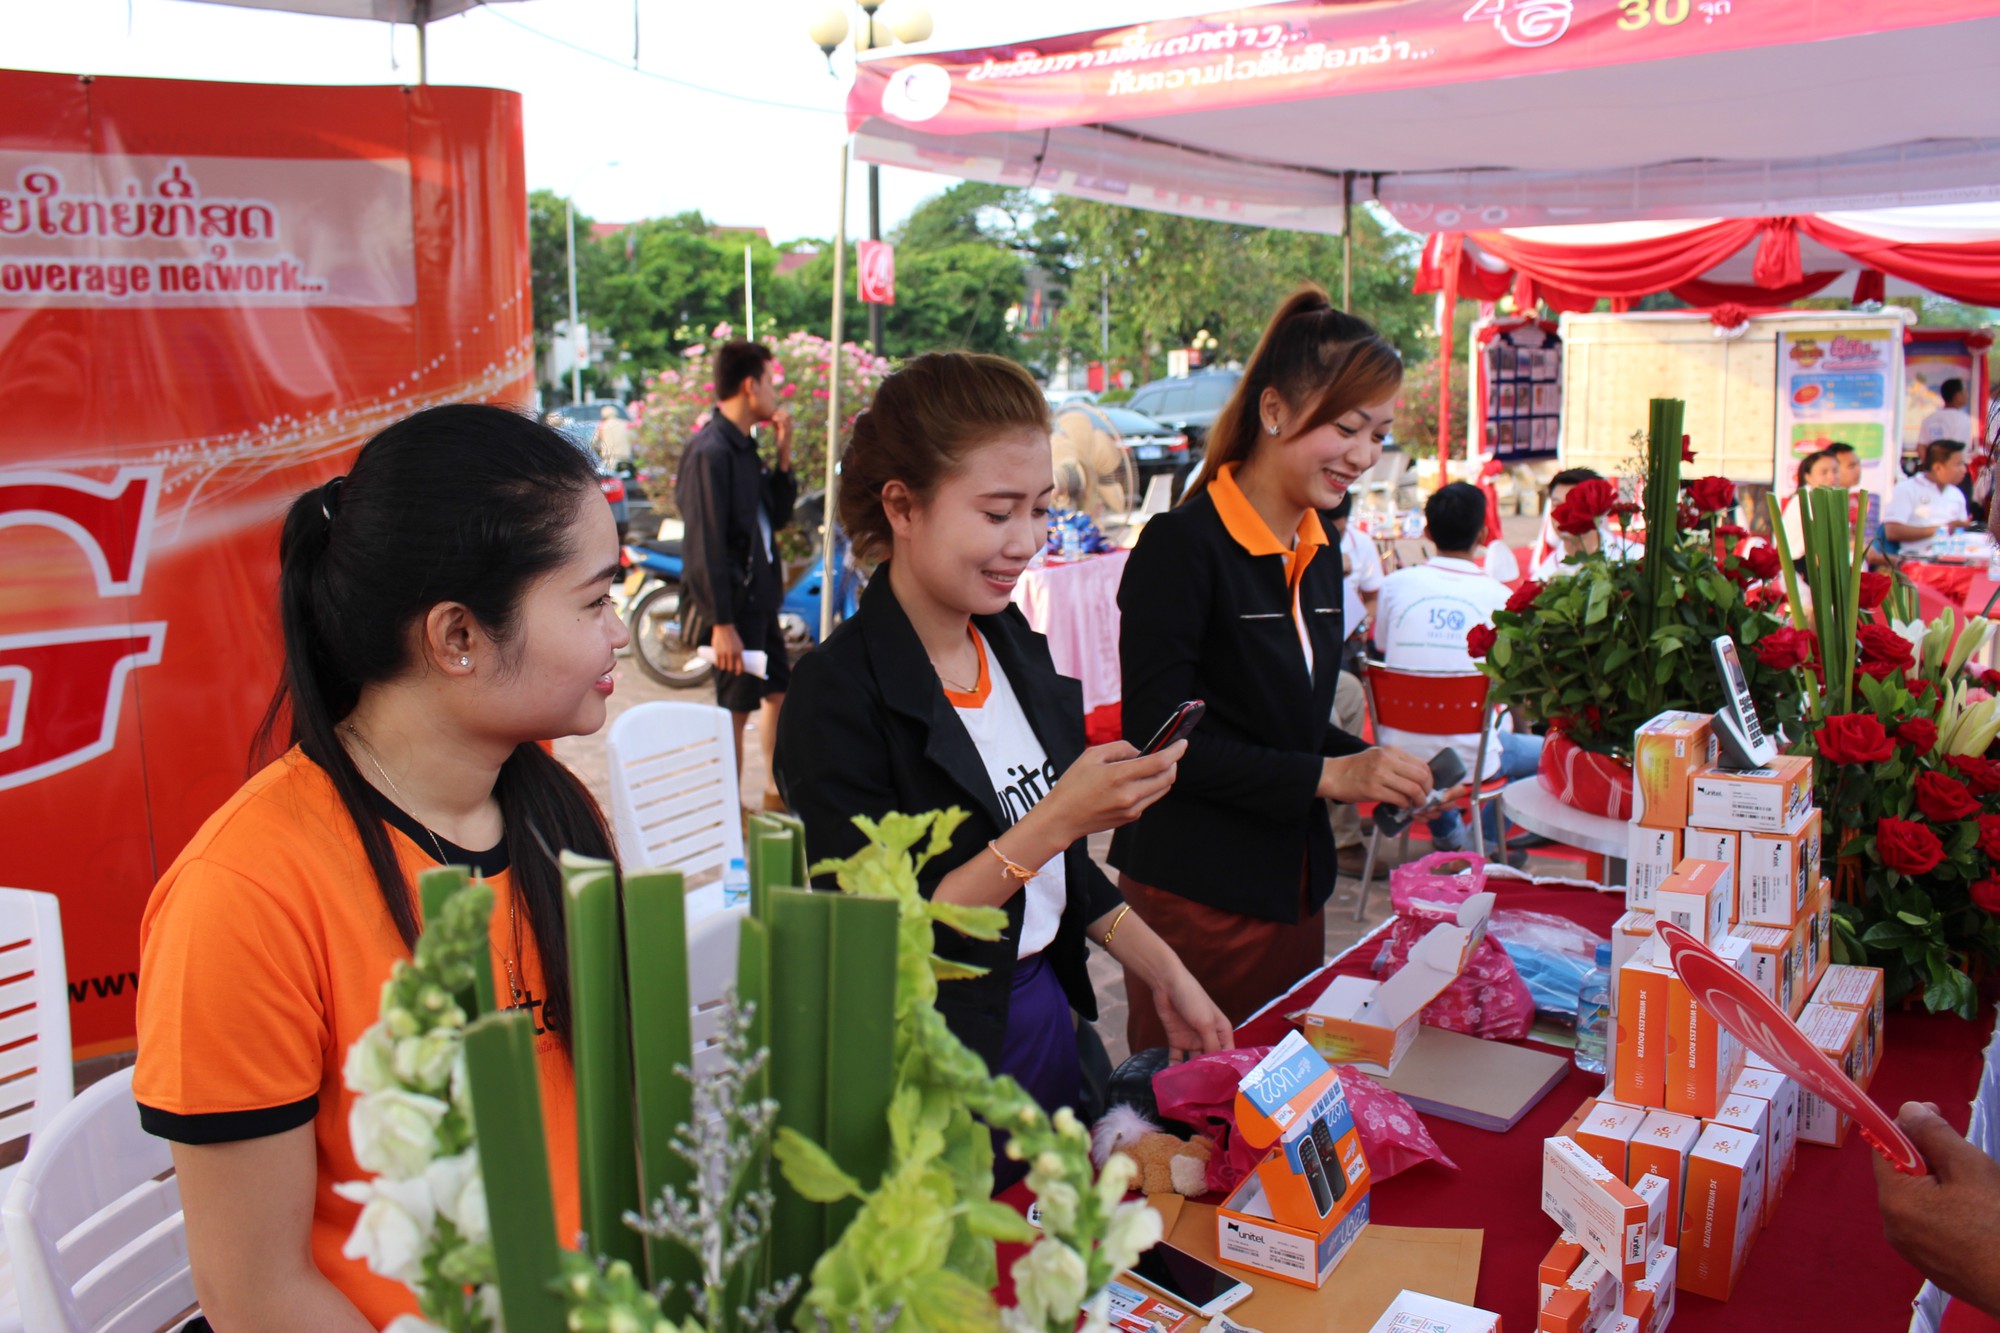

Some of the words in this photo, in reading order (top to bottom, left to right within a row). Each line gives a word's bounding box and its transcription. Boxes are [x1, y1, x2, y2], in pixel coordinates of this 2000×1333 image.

[1617, 0, 1690, 31] 30
[0, 263, 150, 296] overage
[997, 758, 1058, 826] nite
[68, 971, 139, 1003] ww
[1640, 989, 1647, 999] 3G
[1638, 1000, 1646, 1031] WIRELESS
[1690, 999, 1697, 1009] 3G
[1689, 1010, 1697, 1041] WIRELESS
[1637, 1031, 1645, 1058] ROUTER
[1254, 1066, 1299, 1104] U622
[1326, 1099, 1348, 1128] U622
[1710, 1179, 1718, 1189] 3G
[1705, 1189, 1716, 1221] WIRELESS
[1238, 1231, 1265, 1245] unitel
[1341, 1202, 1366, 1243] U622
[1703, 1220, 1712, 1248] ROUTER
[1631, 1235, 1640, 1259] unitel
